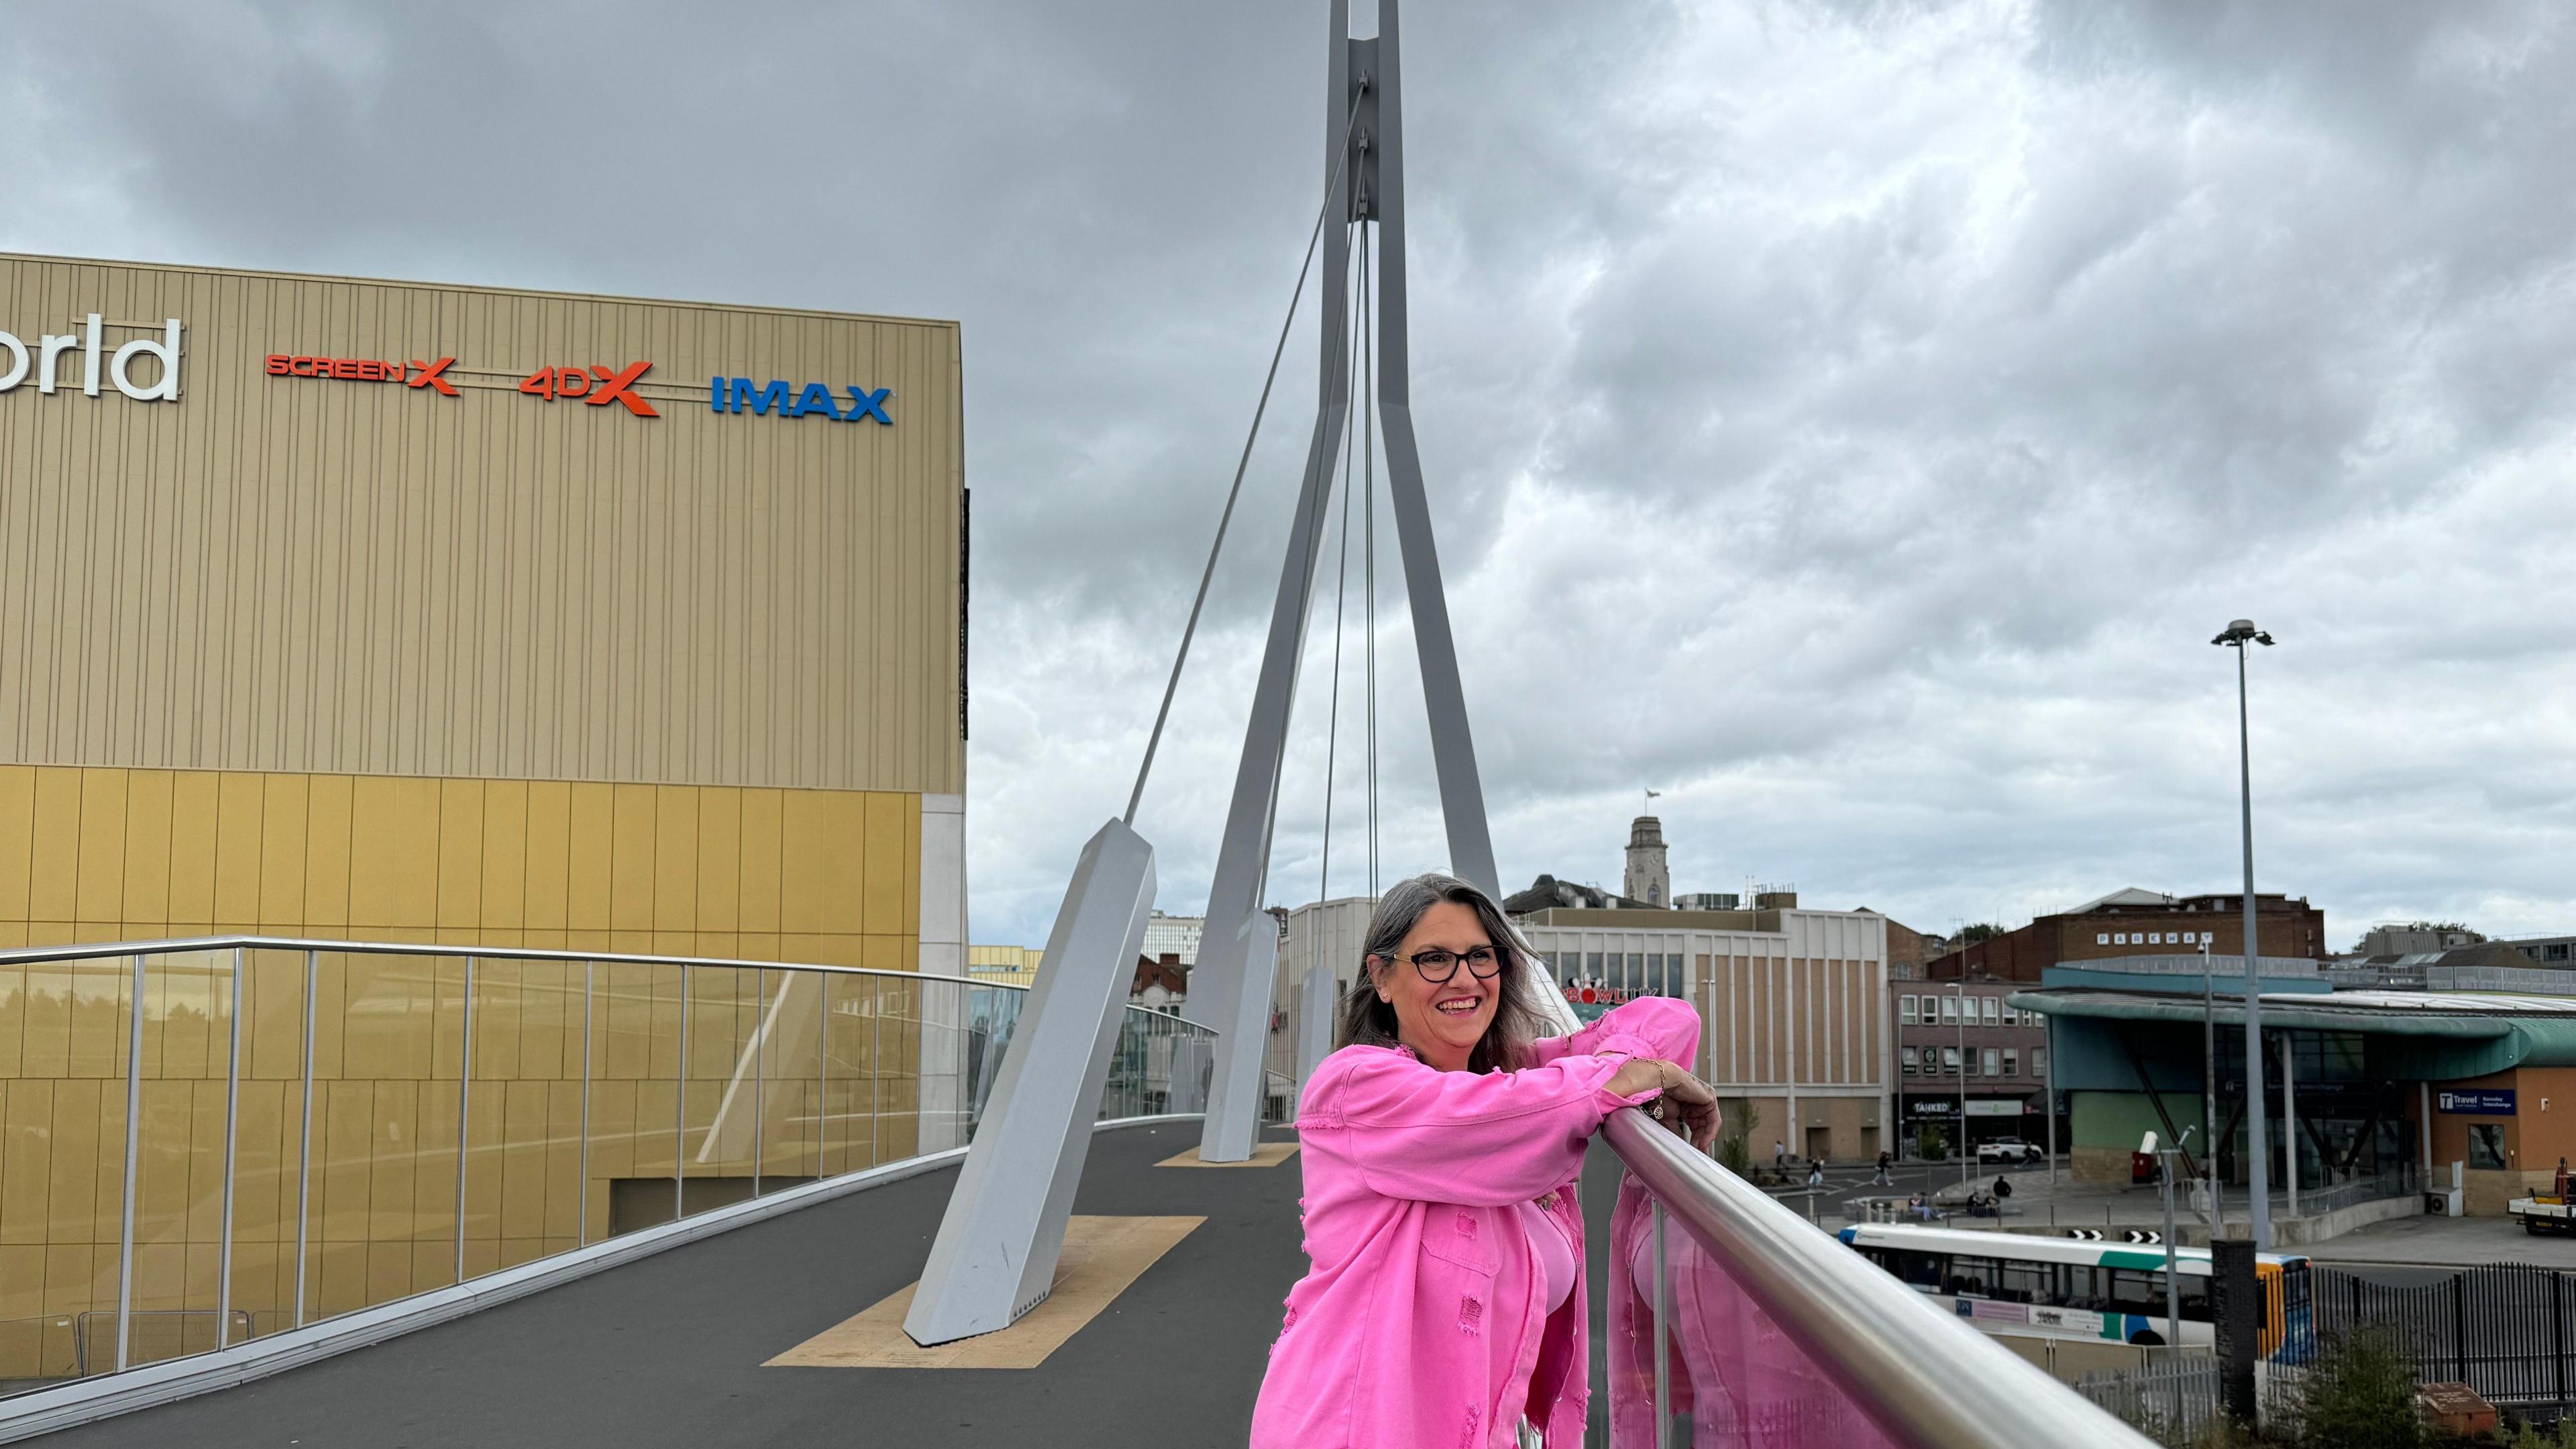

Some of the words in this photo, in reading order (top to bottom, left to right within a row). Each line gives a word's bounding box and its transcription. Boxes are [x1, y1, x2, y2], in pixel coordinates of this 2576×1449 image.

[519, 361, 660, 417] 4DX
[712, 376, 893, 425] IMAX
[2098, 933, 2212, 944] PARKWAY
[2454, 1095, 2477, 1104] Travel
